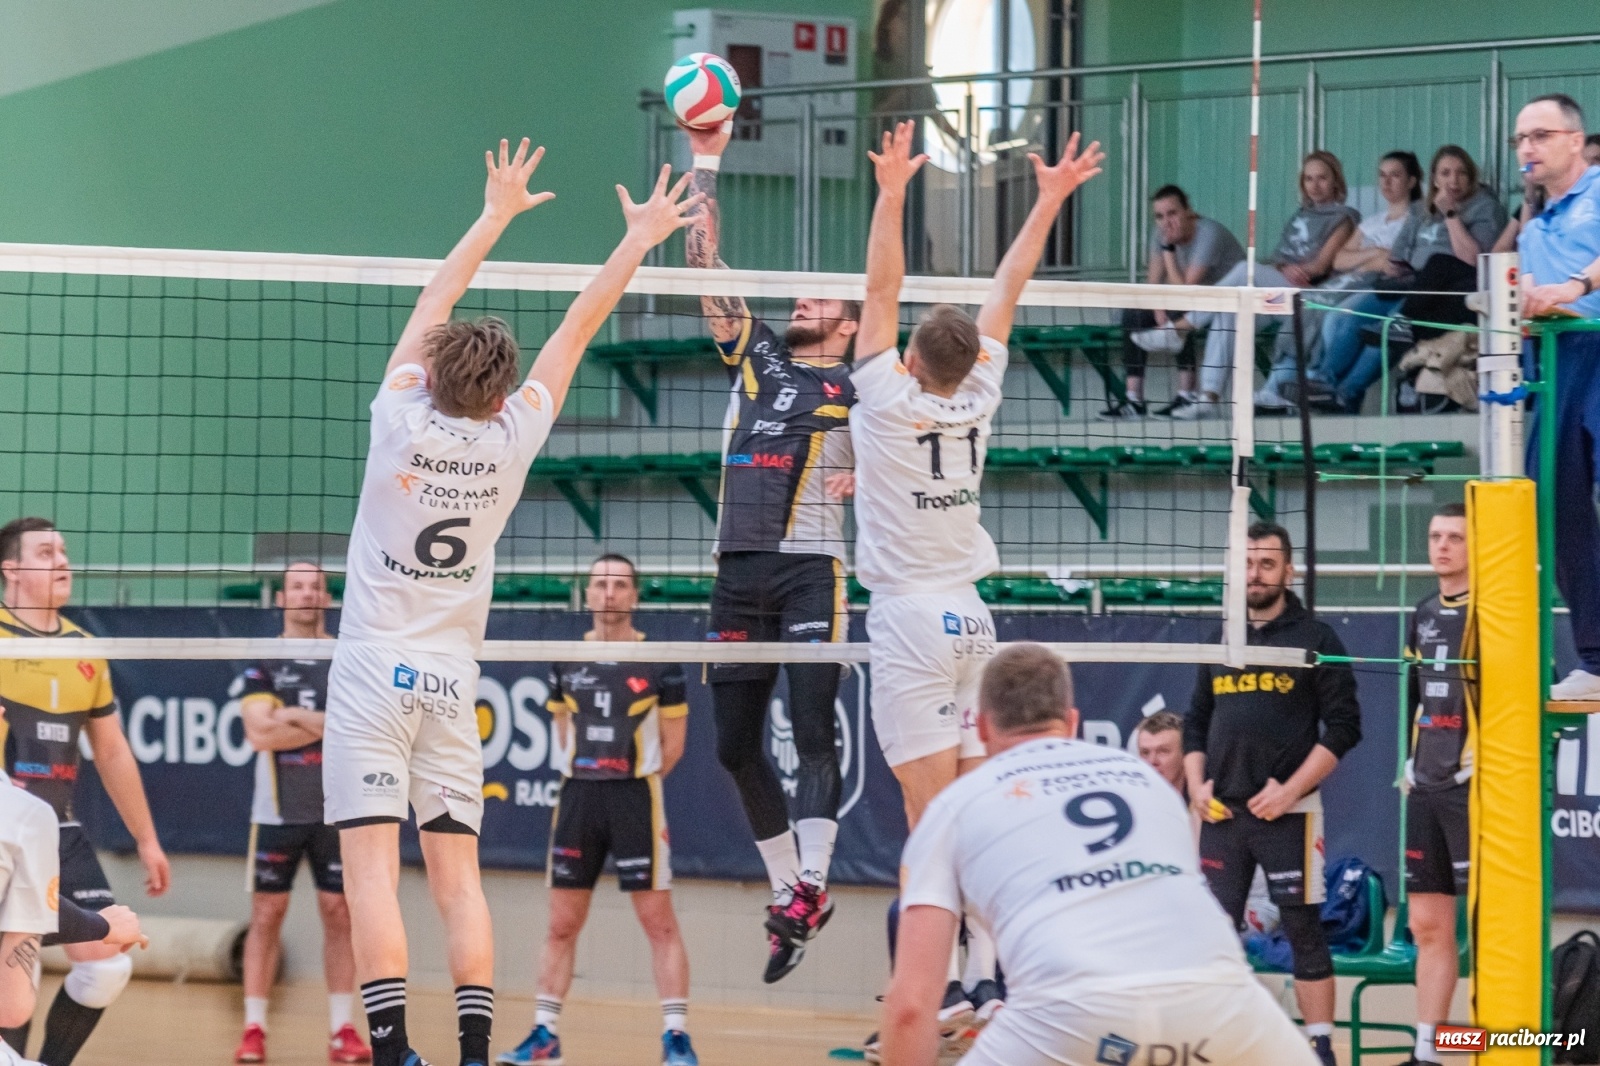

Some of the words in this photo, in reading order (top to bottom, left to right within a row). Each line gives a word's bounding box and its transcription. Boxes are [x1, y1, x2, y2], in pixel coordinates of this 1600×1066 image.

[773, 388, 798, 411] 8
[411, 453, 497, 476] SKORUPA
[917, 428, 979, 480] 11
[419, 495, 499, 511] LUNATYCY
[414, 517, 471, 569] 6
[423, 672, 460, 700] DK
[400, 692, 460, 719] glass
[594, 691, 611, 718] 4
[112, 675, 254, 767] CIBÓ
[515, 779, 561, 807] RAC
[1065, 791, 1135, 856] 9
